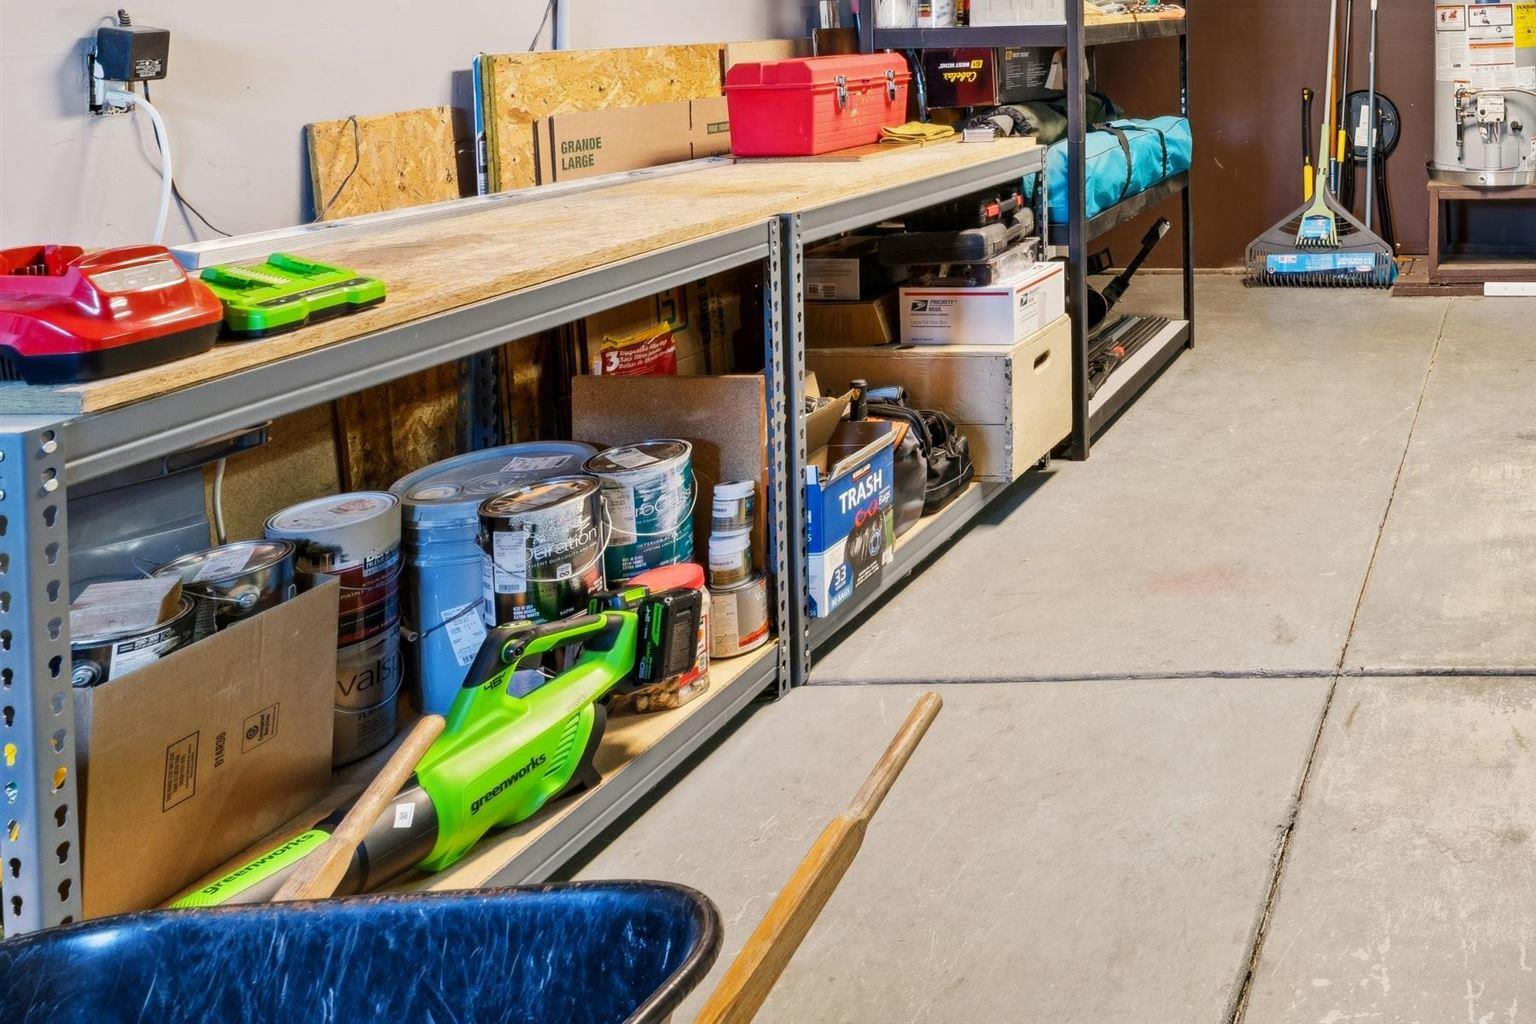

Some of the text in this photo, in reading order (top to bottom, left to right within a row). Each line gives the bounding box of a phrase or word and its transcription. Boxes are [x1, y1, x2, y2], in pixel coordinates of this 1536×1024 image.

[560, 136, 602, 155] GRANDE
[562, 153, 595, 171] LARGE
[605, 350, 620, 372] 3
[839, 468, 883, 514] TRASH
[834, 564, 847, 587] 33
[337, 653, 398, 696] vals
[471, 753, 547, 816] greenworks
[202, 833, 314, 895] greenworks
